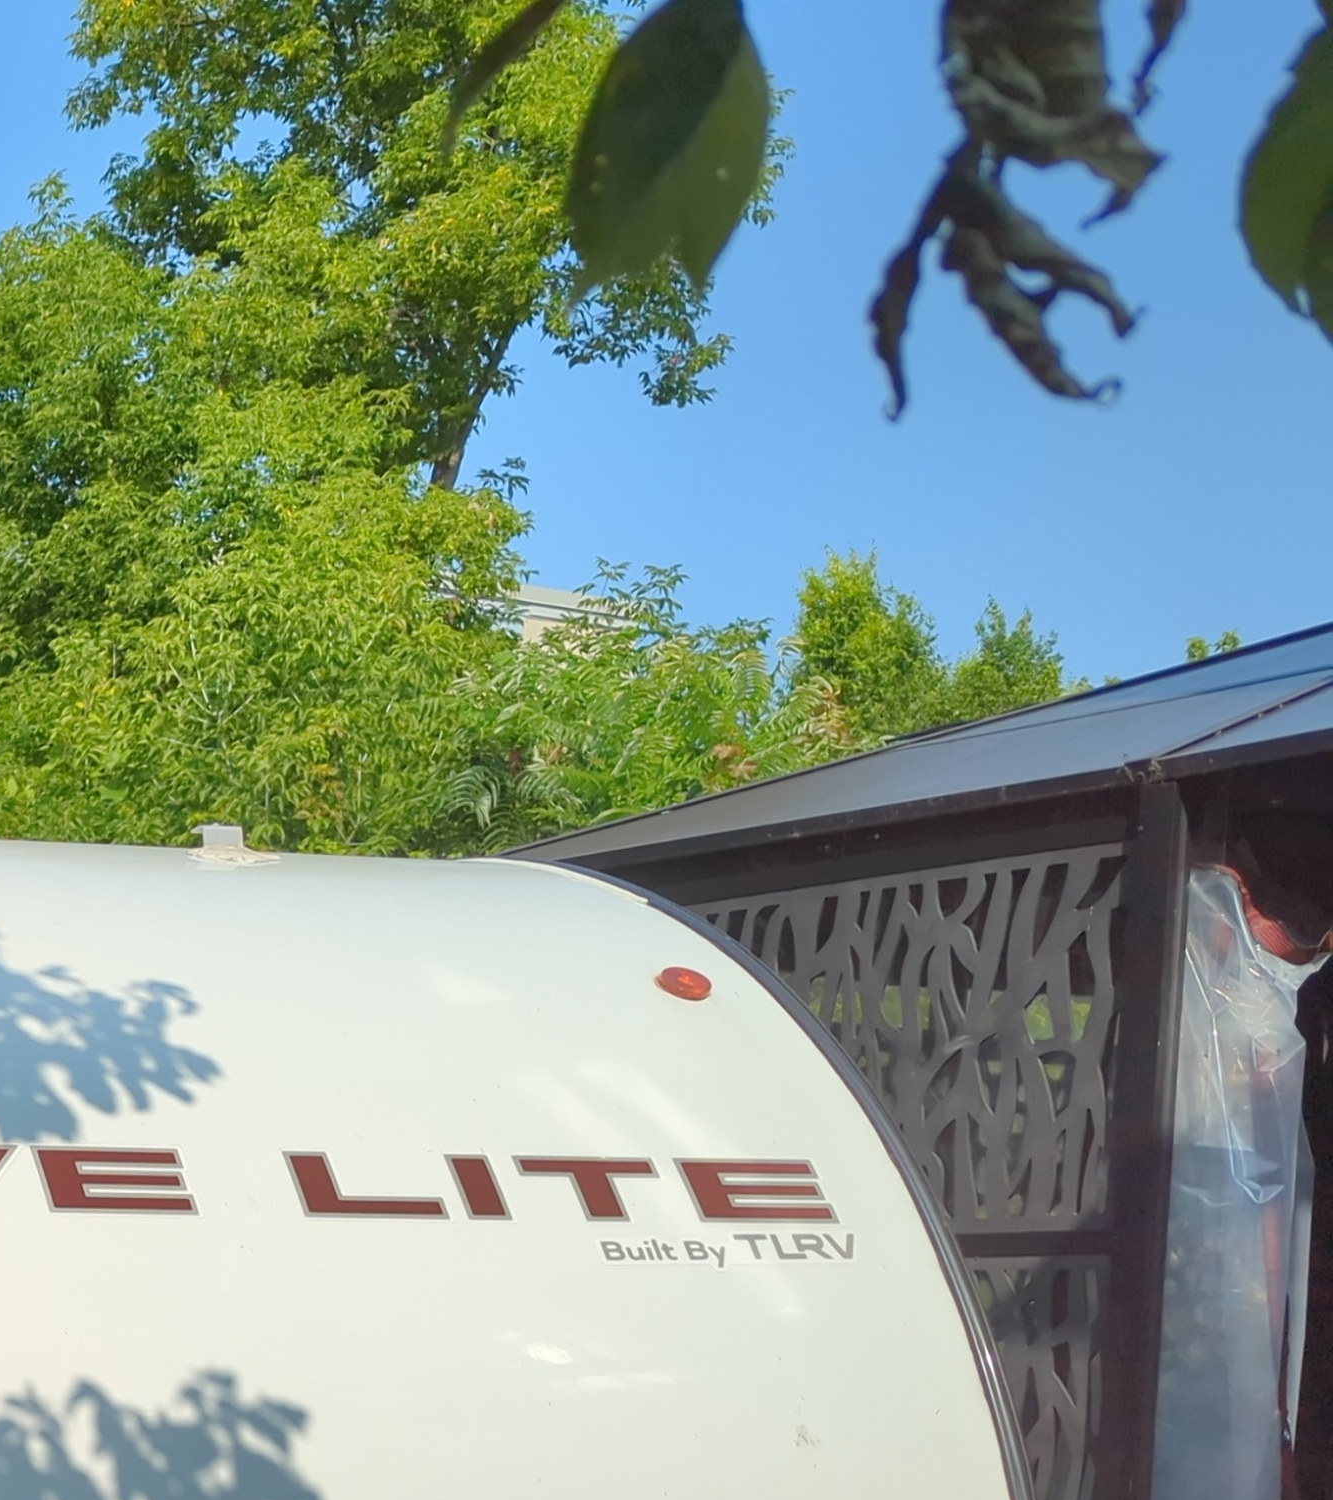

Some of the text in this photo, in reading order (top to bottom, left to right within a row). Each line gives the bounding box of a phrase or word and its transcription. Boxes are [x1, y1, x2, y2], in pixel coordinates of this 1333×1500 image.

[282, 1151, 840, 1224] LITE
[600, 1234, 854, 1268] Built By TLRV
